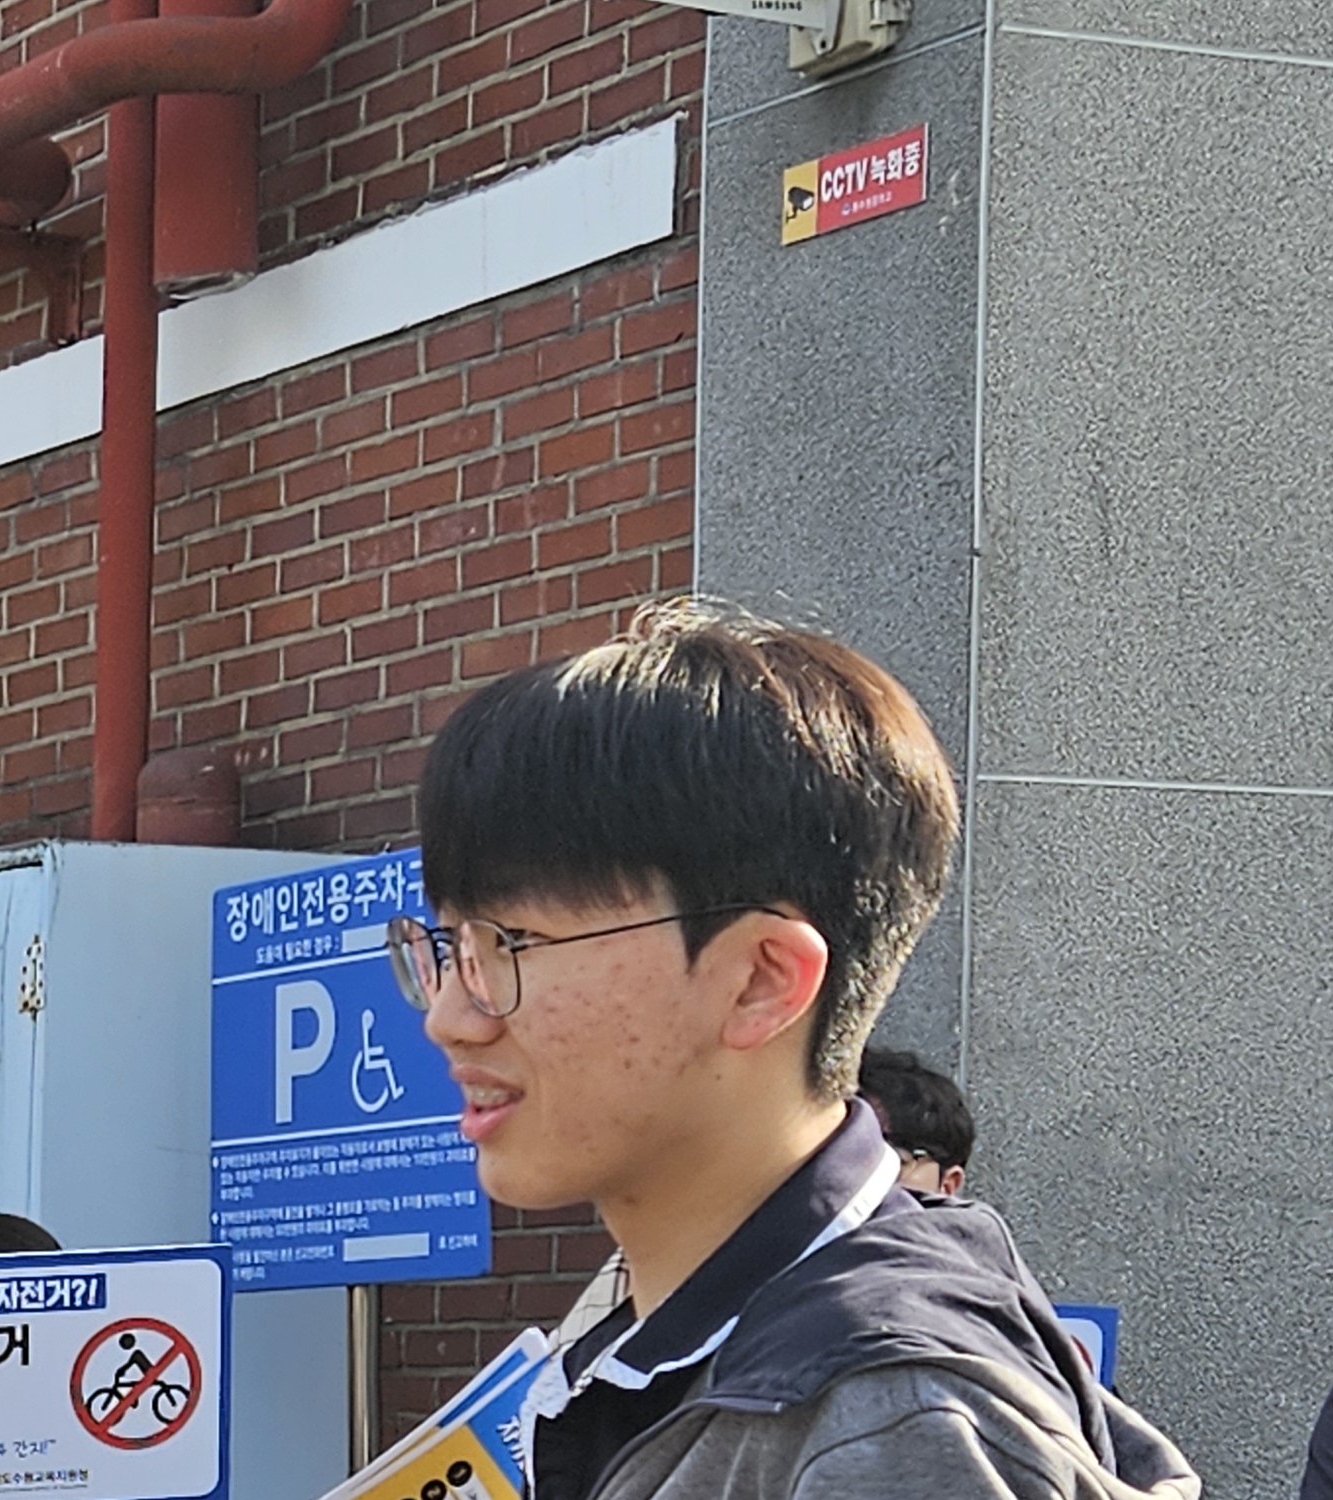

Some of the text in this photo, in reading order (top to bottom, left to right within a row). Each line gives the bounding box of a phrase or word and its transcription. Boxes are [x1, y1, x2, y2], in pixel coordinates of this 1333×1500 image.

[820, 140, 921, 203] CCTV 녹화중
[275, 979, 337, 1125] P
